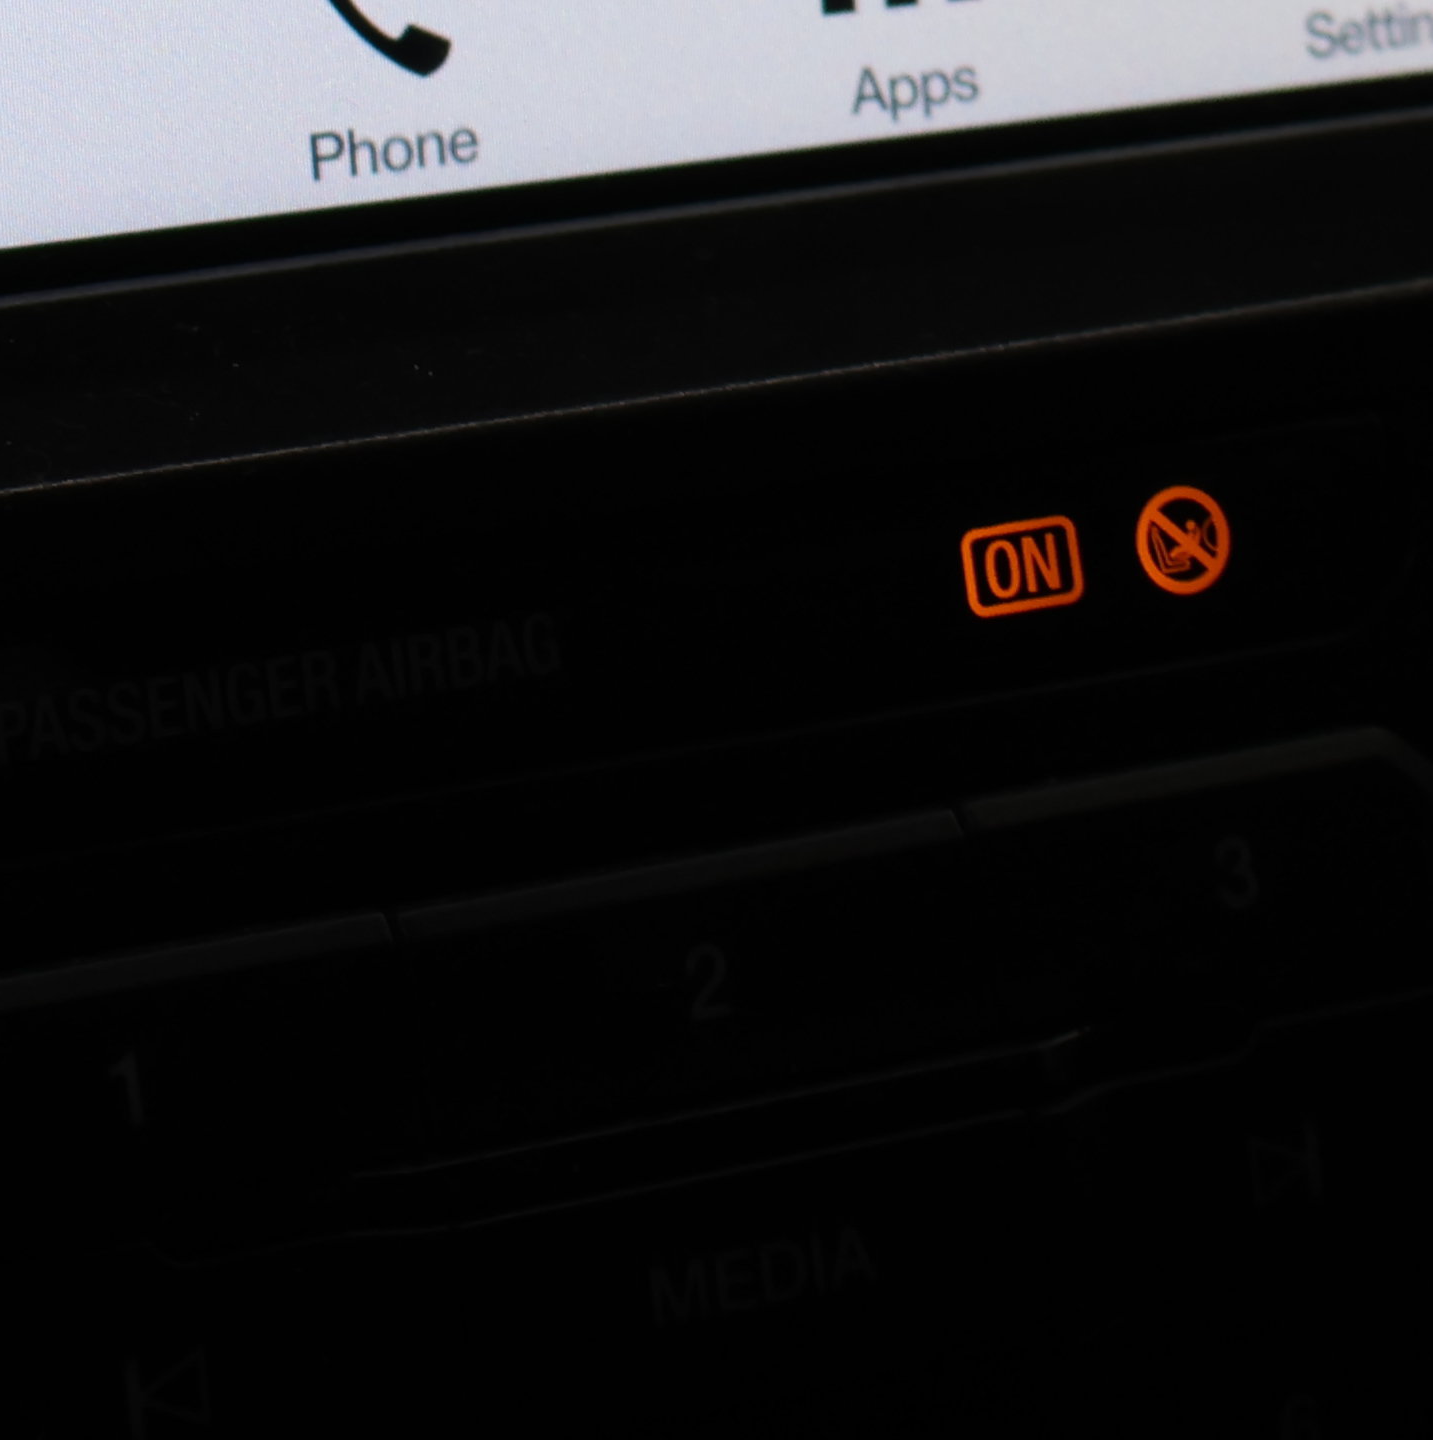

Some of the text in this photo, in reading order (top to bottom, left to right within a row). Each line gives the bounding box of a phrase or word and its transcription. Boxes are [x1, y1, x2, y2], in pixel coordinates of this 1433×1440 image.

[851, 60, 980, 122] Apps
[307, 121, 480, 182] Phone
[983, 534, 1064, 598] ON
[354, 611, 565, 704] AIRBAG
[1213, 836, 1262, 911] 3
[682, 945, 735, 1023] 2
[648, 1225, 879, 1328] MEDIA
